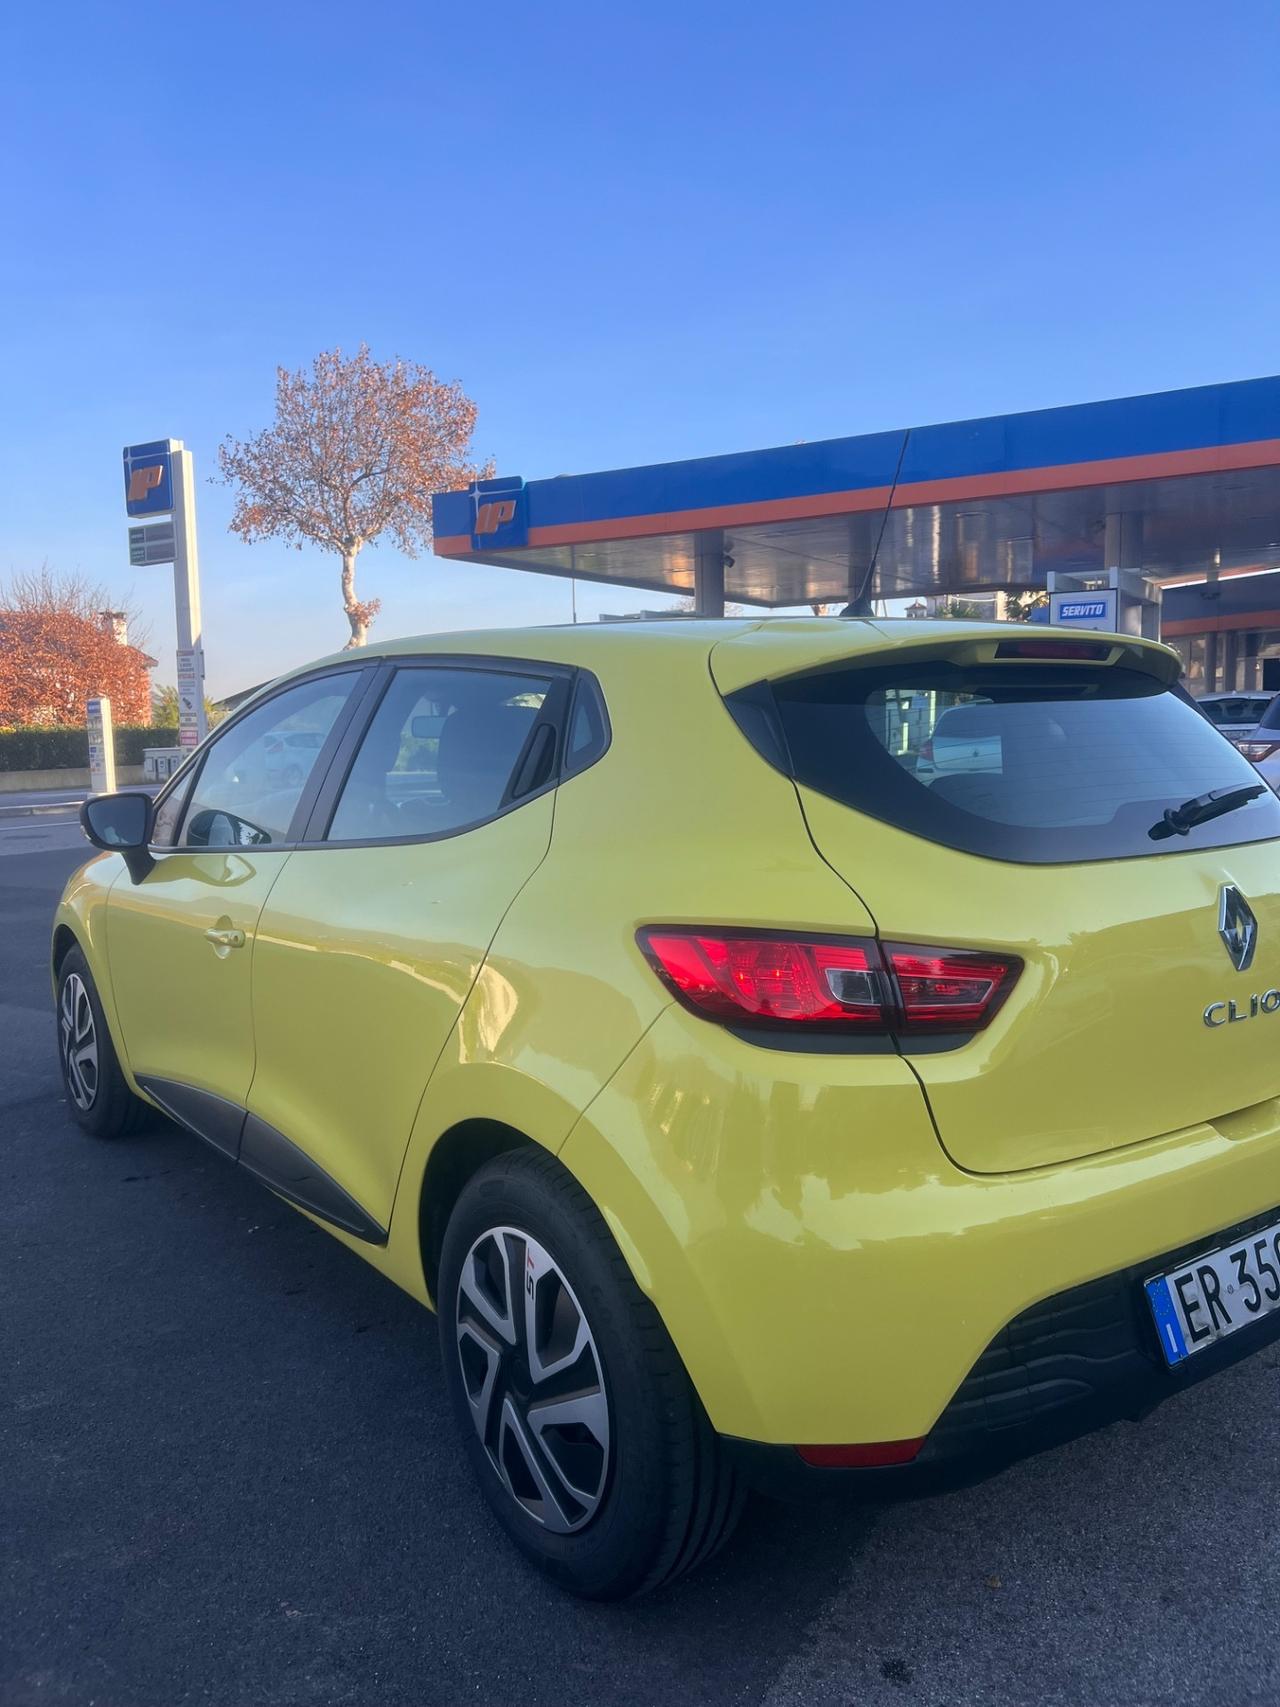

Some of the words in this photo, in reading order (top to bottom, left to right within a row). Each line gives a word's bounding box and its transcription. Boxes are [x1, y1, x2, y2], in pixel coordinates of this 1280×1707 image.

[128, 464, 164, 501] IP
[475, 500, 517, 534] IP
[1061, 604, 1104, 617] SERVITO
[1203, 988, 1280, 1028] CLIO
[1174, 1265, 1233, 1344] ER
